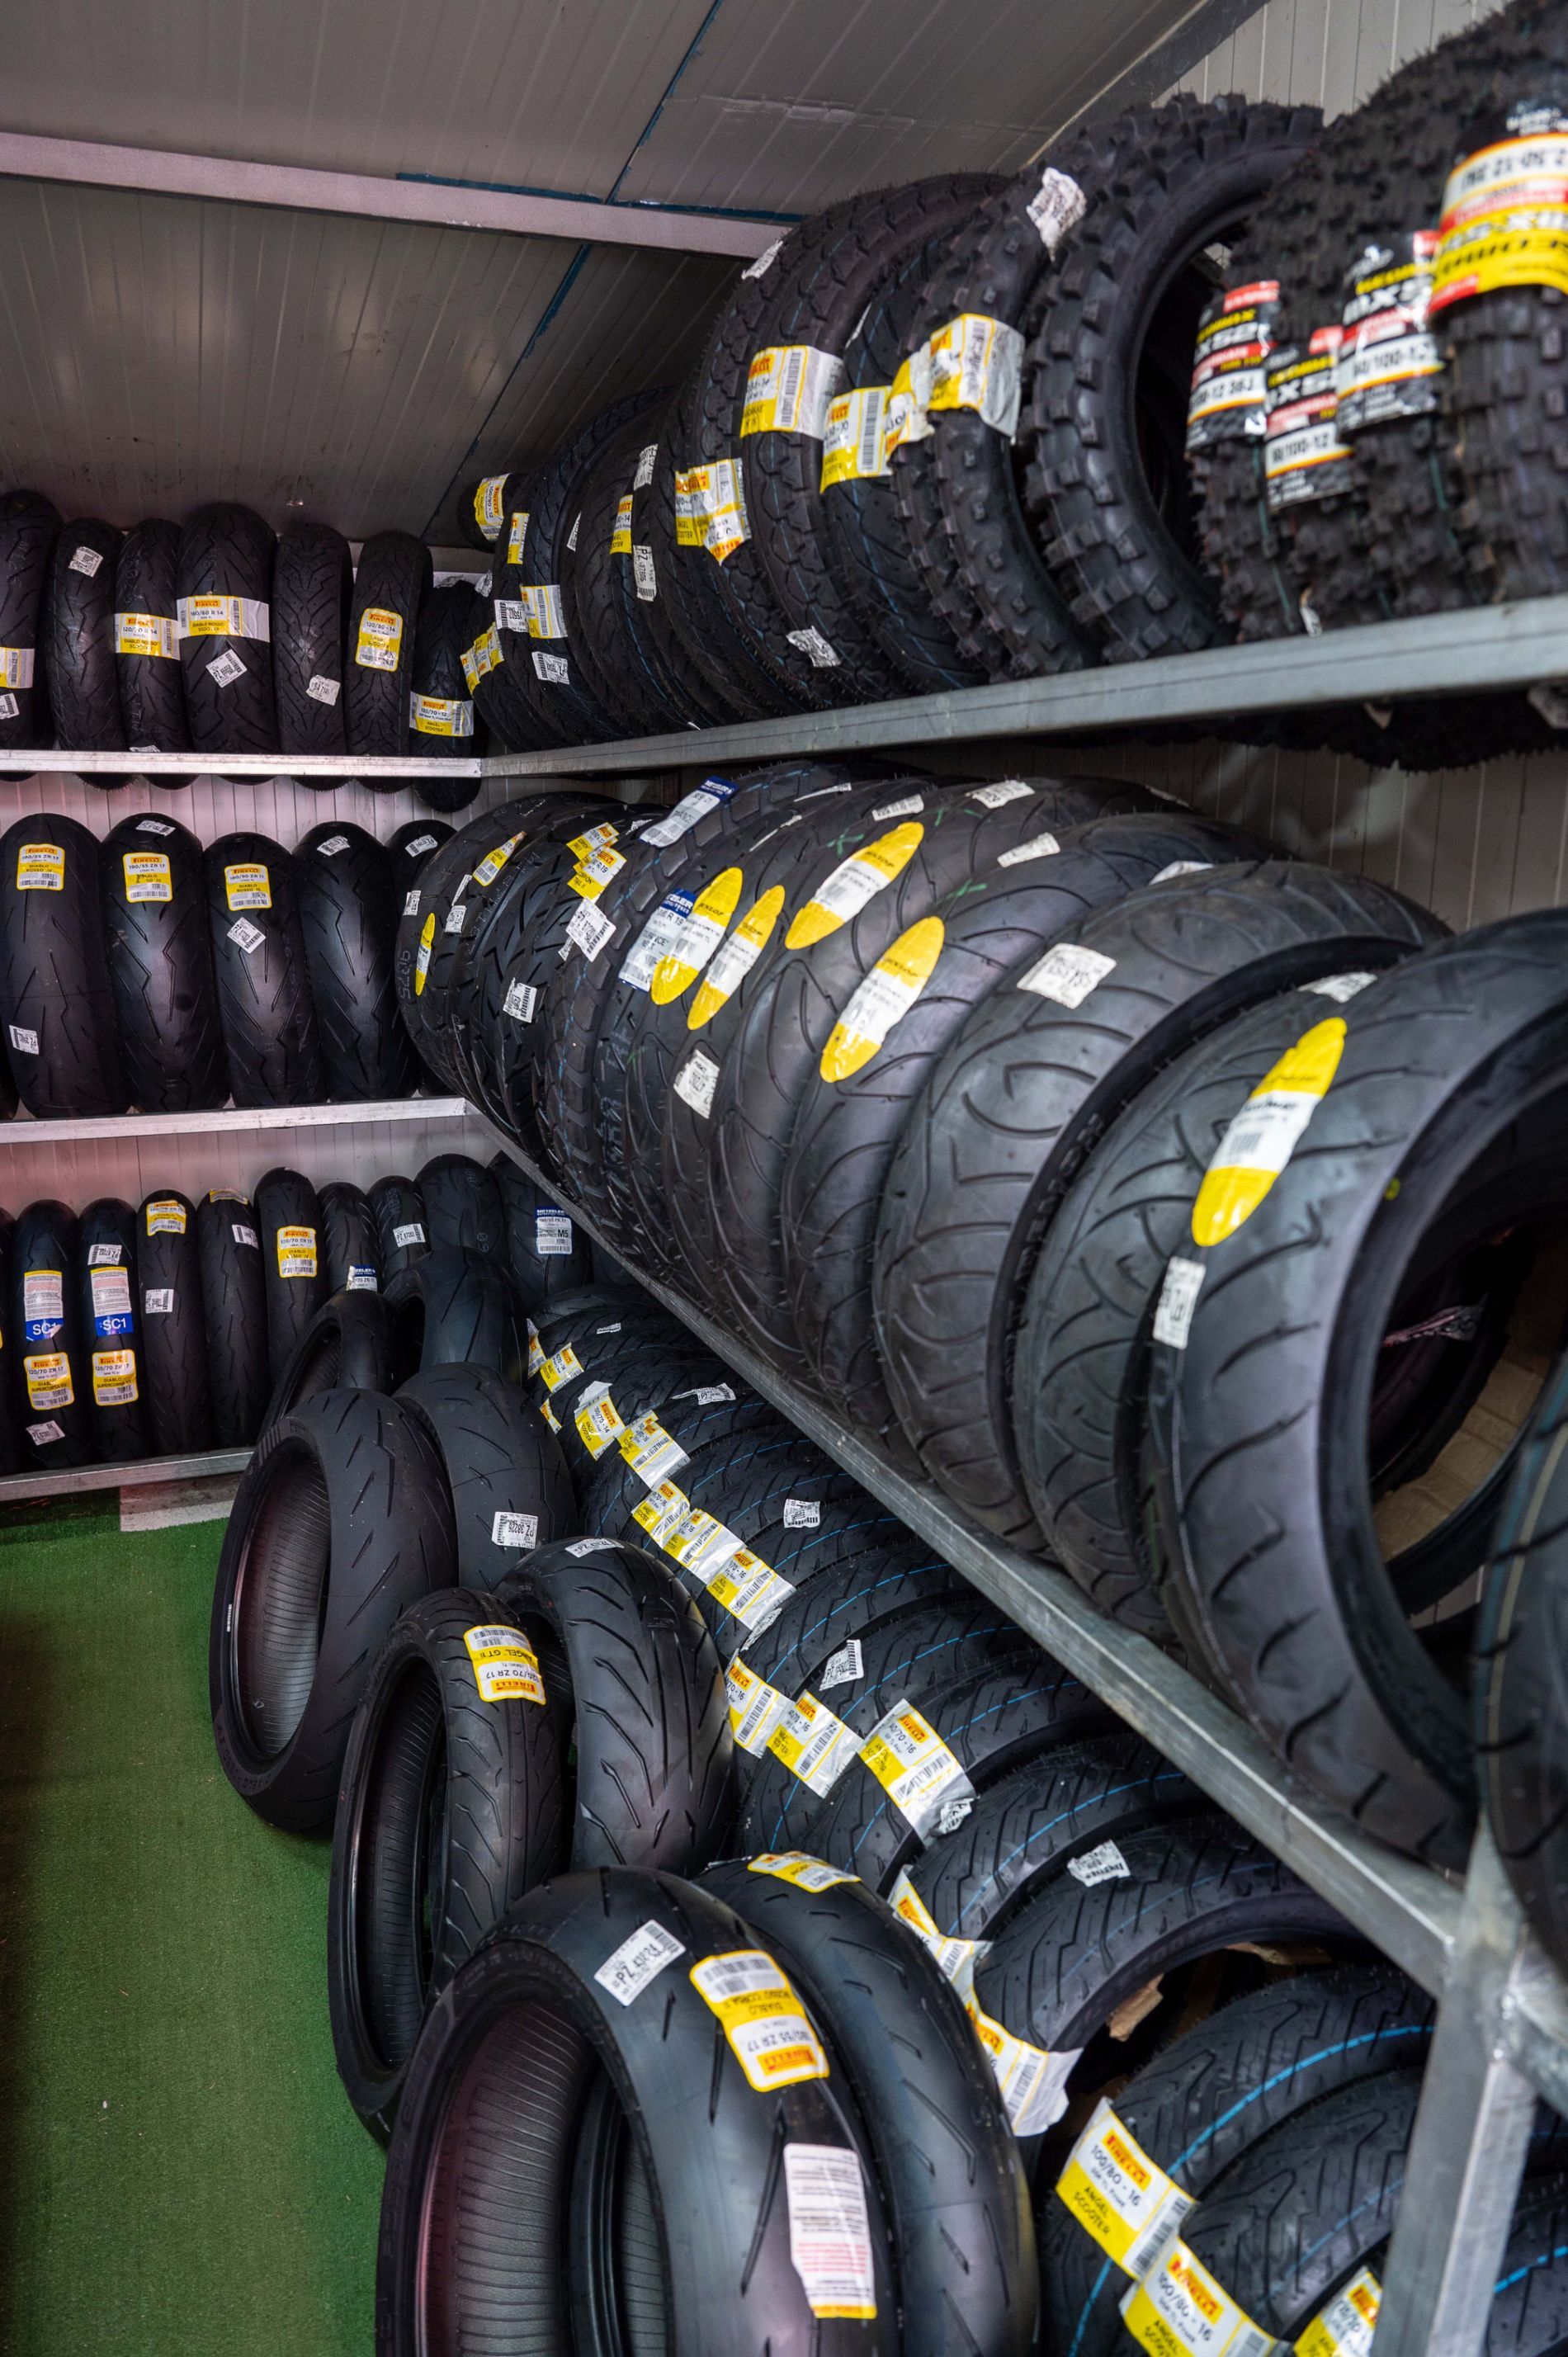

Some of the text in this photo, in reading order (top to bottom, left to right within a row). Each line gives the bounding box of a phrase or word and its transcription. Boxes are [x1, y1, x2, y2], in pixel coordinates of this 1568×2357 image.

[640, 548, 649, 561] PZ
[423, 701, 445, 710] PIRELLI
[557, 1230, 569, 1238] M5
[102, 1318, 127, 1332] SC1
[601, 1403, 616, 1425] PIRELLI
[526, 1525, 534, 1537] PZ
[496, 1680, 536, 1693] PIRELLI
[898, 1716, 925, 1742] PIRELLI
[908, 1743, 917, 1755] 16
[616, 1962, 636, 1986] PZ
[746, 2041, 760, 2053] 17
[761, 2035, 778, 2048] ZR
[764, 2048, 815, 2070] PIRELLI
[1106, 2134, 1148, 2185] PIRELLI
[1091, 2144, 1142, 2208] 100/80 16
[1084, 2186, 1110, 2218] ANGEL
[1074, 2191, 1111, 2236] SCOOTER
[1158, 2271, 1213, 2342] 100/80 16
